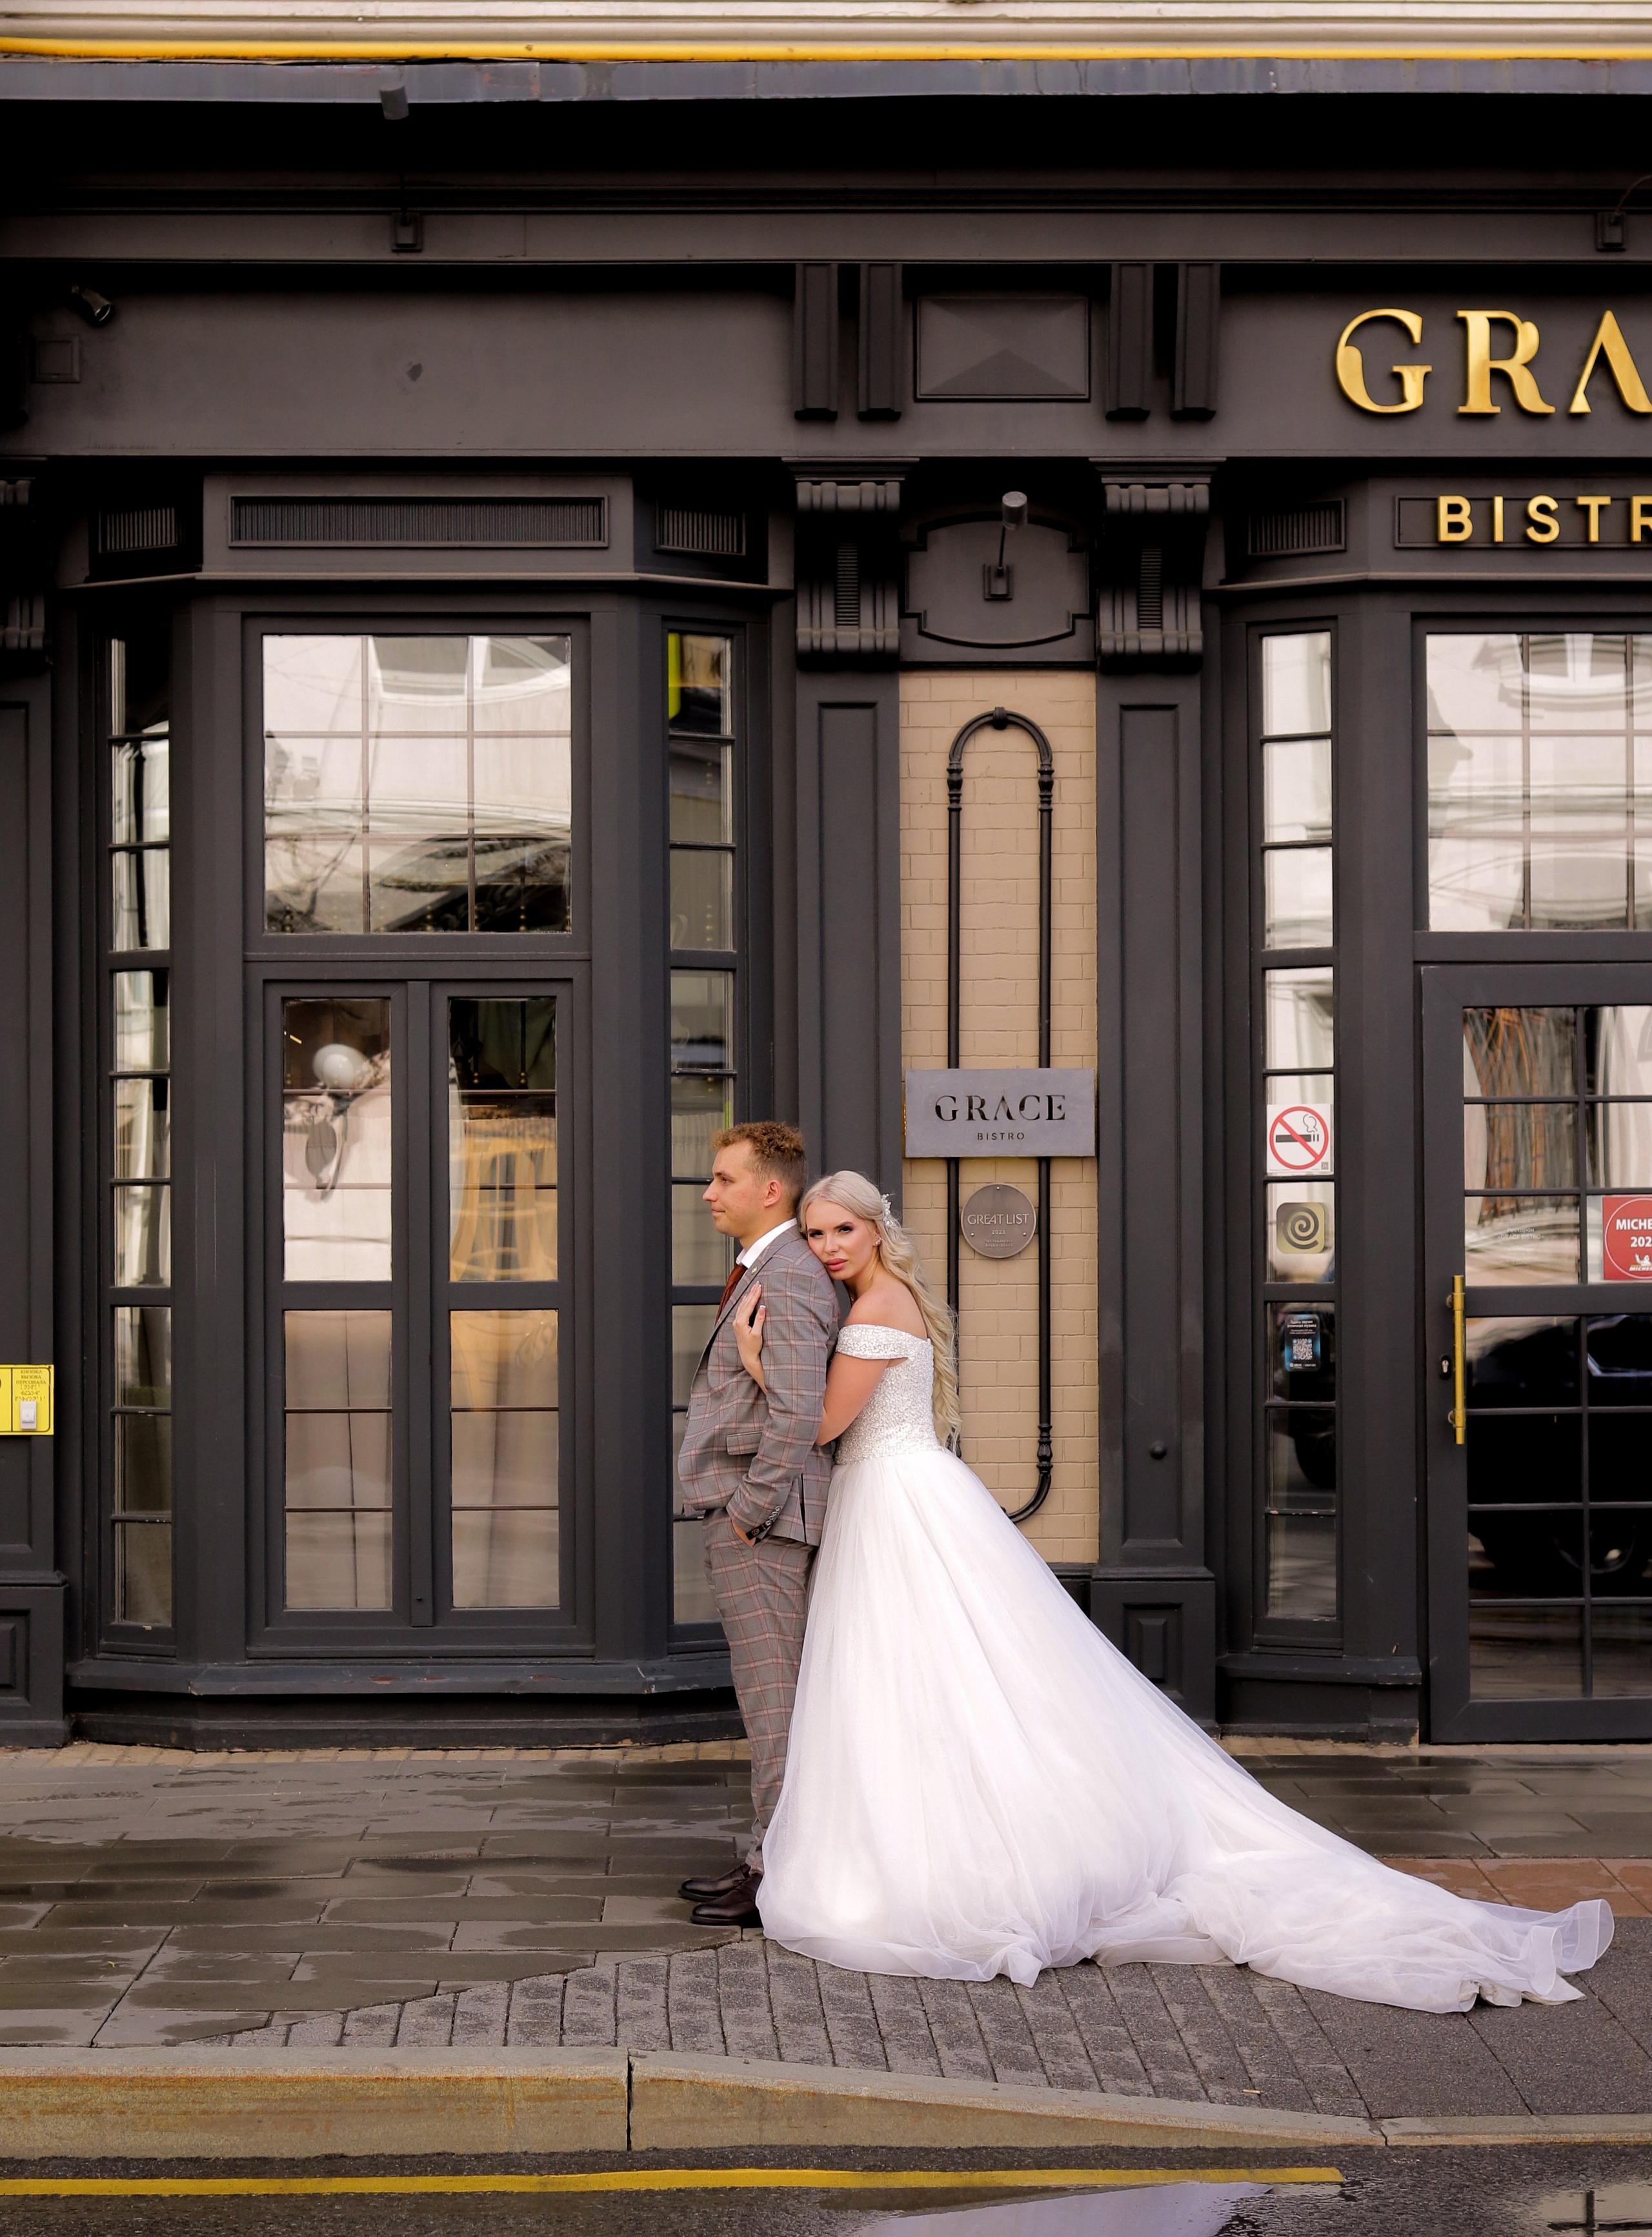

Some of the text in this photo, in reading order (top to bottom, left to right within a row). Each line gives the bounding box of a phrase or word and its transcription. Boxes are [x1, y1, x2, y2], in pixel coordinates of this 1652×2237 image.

[1336, 308, 1652, 413] GRA
[935, 1095, 1065, 1122] GRACE
[977, 1132, 1025, 1140] BISTRO
[967, 1213, 1030, 1225] GREAT LIST
